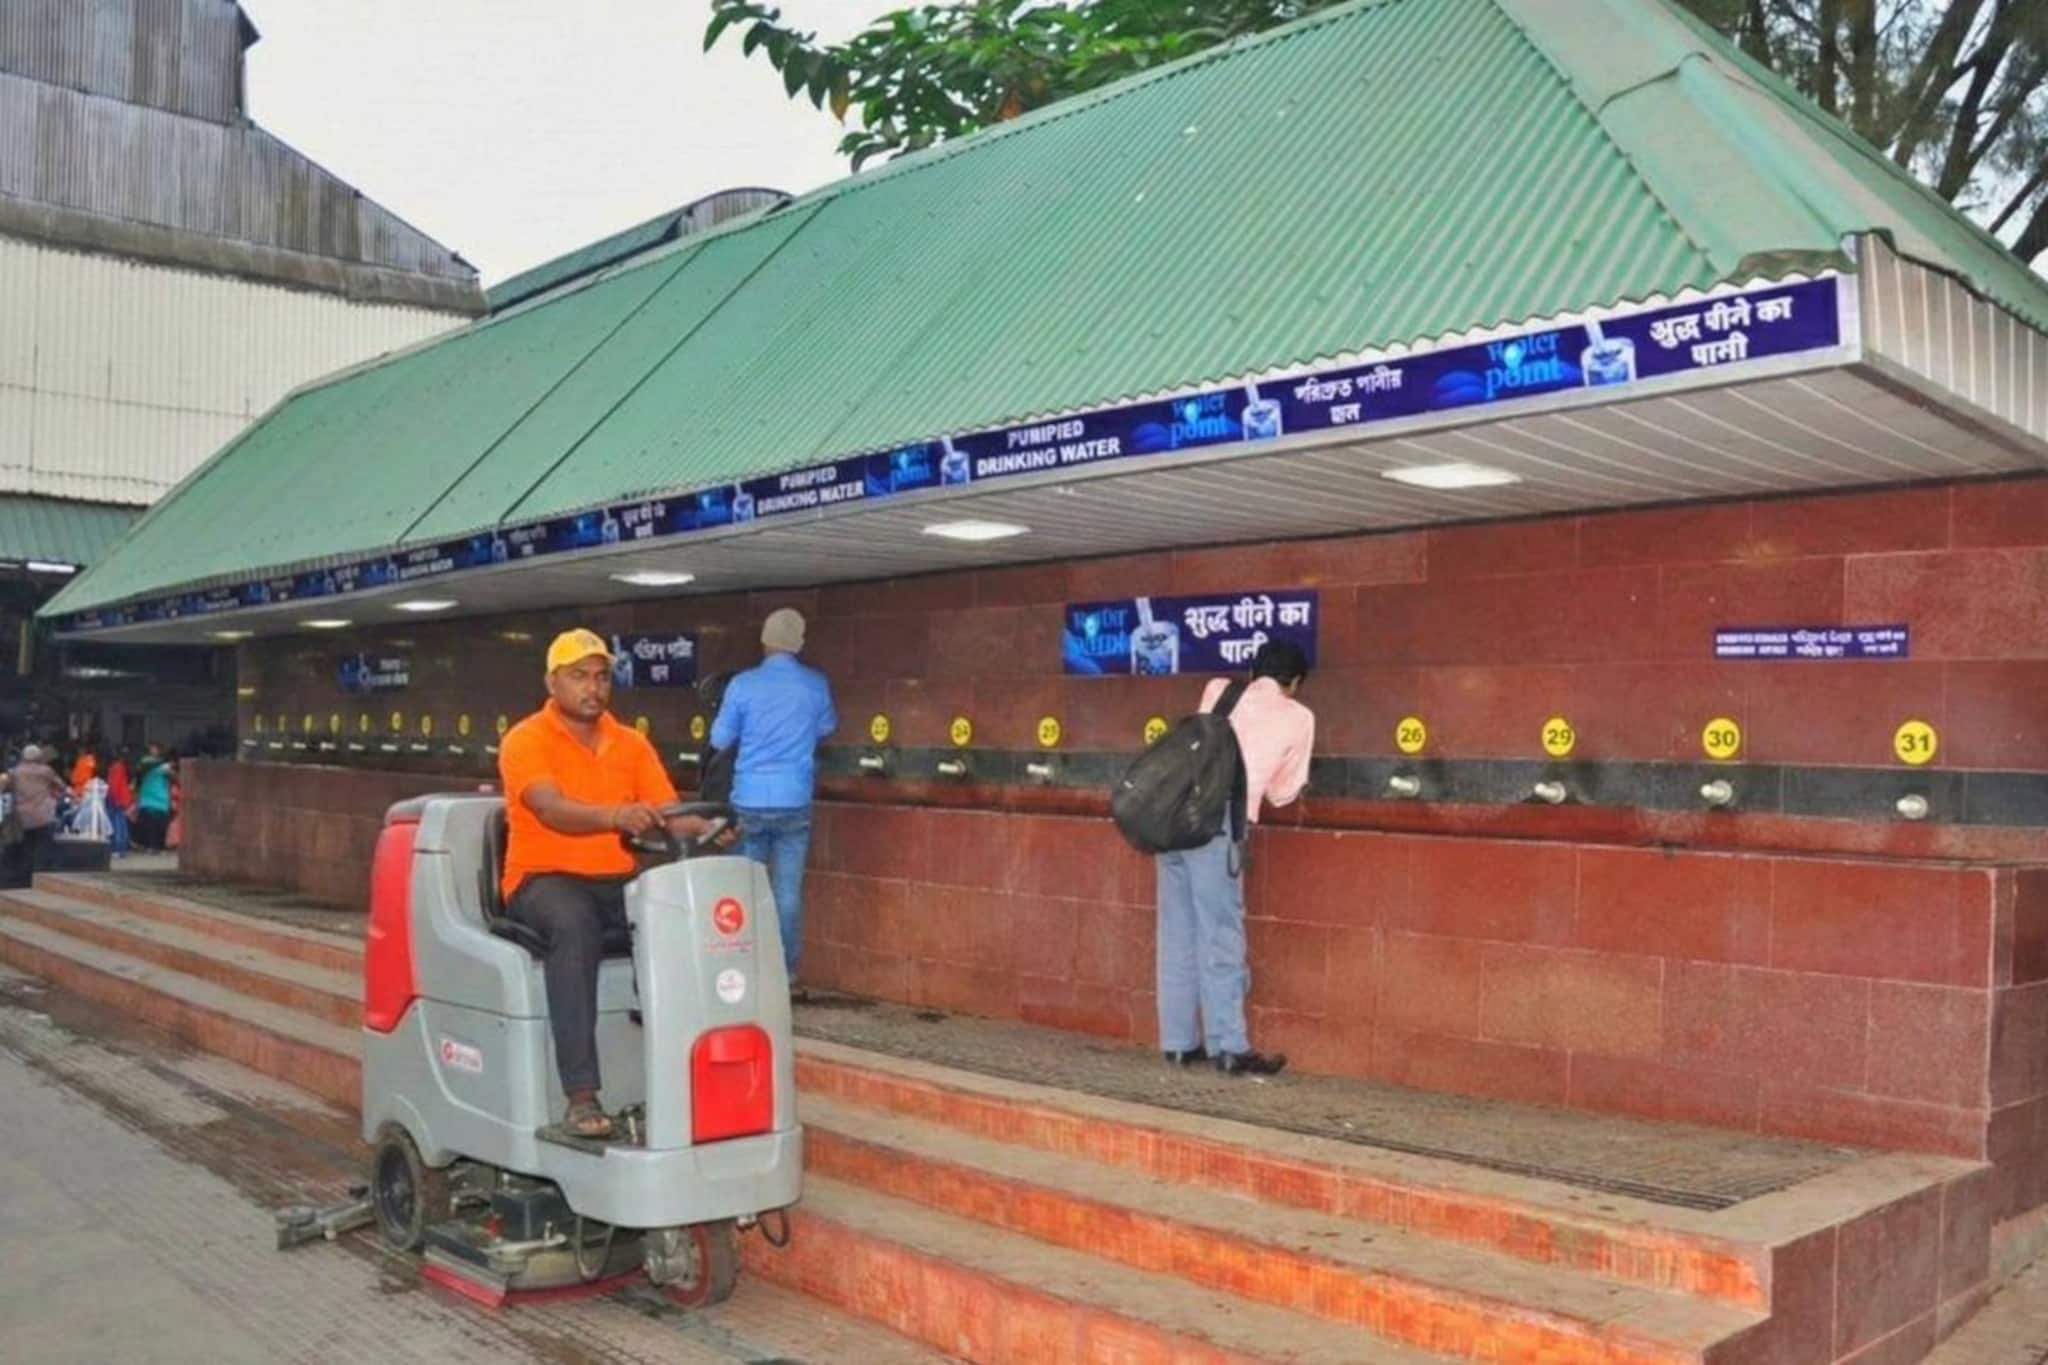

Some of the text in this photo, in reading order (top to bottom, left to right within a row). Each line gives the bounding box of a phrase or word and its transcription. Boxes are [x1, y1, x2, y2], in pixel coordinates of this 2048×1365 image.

[1755, 296, 1794, 322] का
[1060, 436, 1121, 463] WATER
[1184, 595, 1311, 639] शुद्ध पीने का
[1547, 728, 1572, 746] 29
[1708, 729, 1736, 748] 30
[1900, 733, 1930, 753] 31
